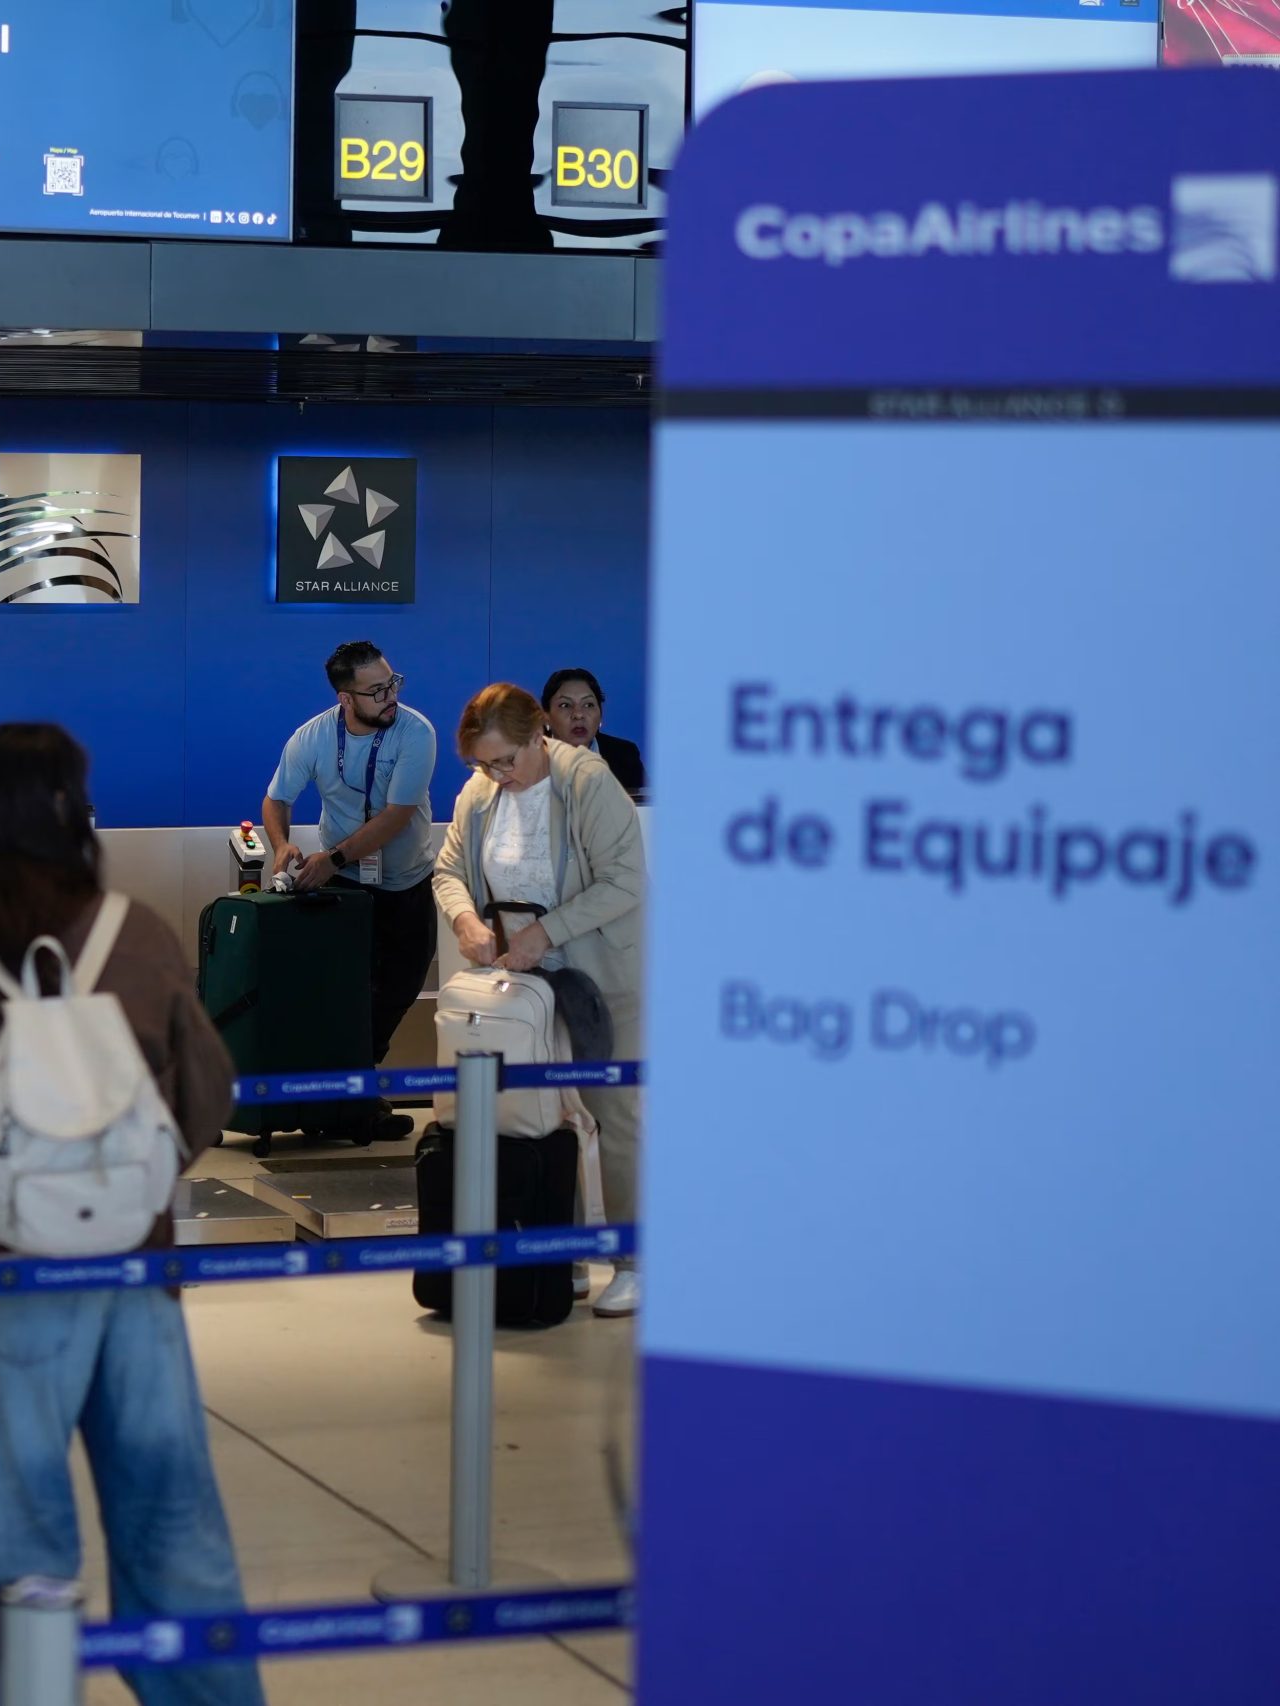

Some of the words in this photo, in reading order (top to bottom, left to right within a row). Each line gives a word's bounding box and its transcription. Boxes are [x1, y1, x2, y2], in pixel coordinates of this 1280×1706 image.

[340, 137, 425, 182] B29
[556, 145, 639, 190] B30
[735, 199, 1163, 267] CopaAirlines
[295, 581, 330, 592] STAR
[333, 581, 399, 592] ALLIANCE
[730, 680, 1074, 784] Entrega
[725, 794, 834, 868] de
[862, 797, 1259, 908] Equipaje
[719, 980, 852, 1064] Bag
[870, 986, 1036, 1072] Drop
